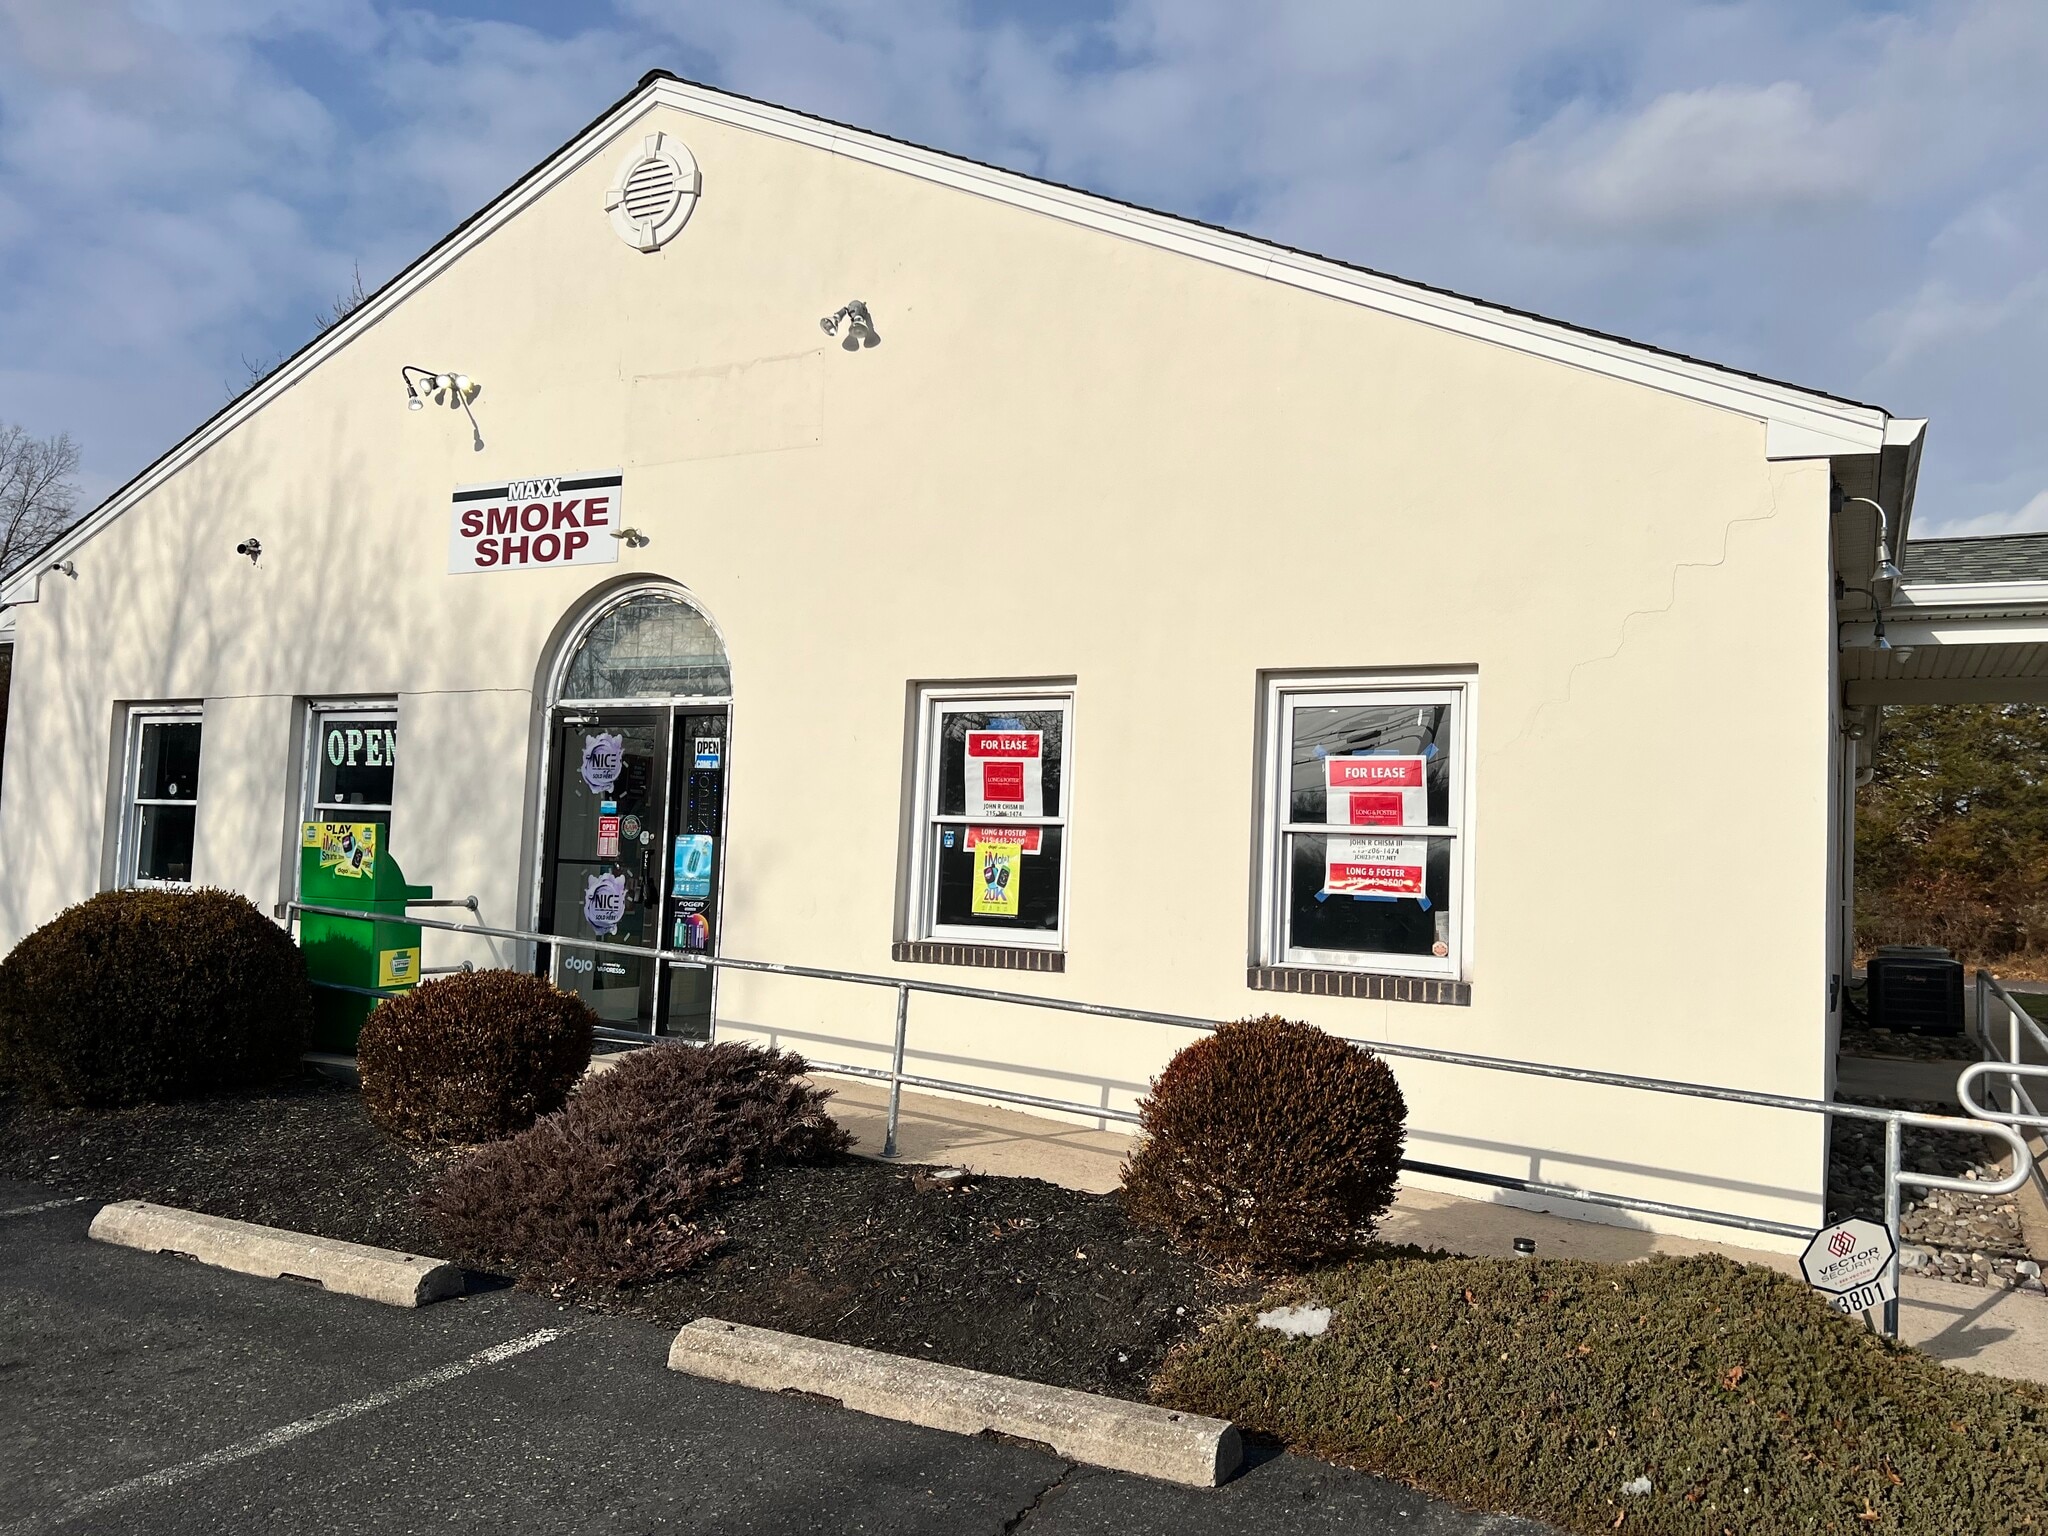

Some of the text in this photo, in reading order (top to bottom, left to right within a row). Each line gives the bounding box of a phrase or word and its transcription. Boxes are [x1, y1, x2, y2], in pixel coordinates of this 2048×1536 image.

[507, 477, 561, 501] MAXX
[460, 497, 609, 538] SMOKE
[475, 531, 589, 567] SHOP
[328, 729, 397, 766] OPEN
[697, 741, 719, 754] OPEN
[981, 740, 1027, 750] FOR LEASE
[592, 754, 616, 767] NICE
[1345, 767, 1405, 778] FOR LEASE
[326, 825, 351, 834] PLAY
[982, 828, 997, 836] LONG
[1004, 829, 1027, 837] FOSTER
[1346, 867, 1405, 877] LONG & FOSTER
[595, 894, 619, 909] NICE
[565, 956, 593, 973] dojo
[1819, 1247, 1879, 1275] VECTOR
[1821, 1254, 1881, 1283] SECURITY
[1837, 1282, 1885, 1315] 3801
